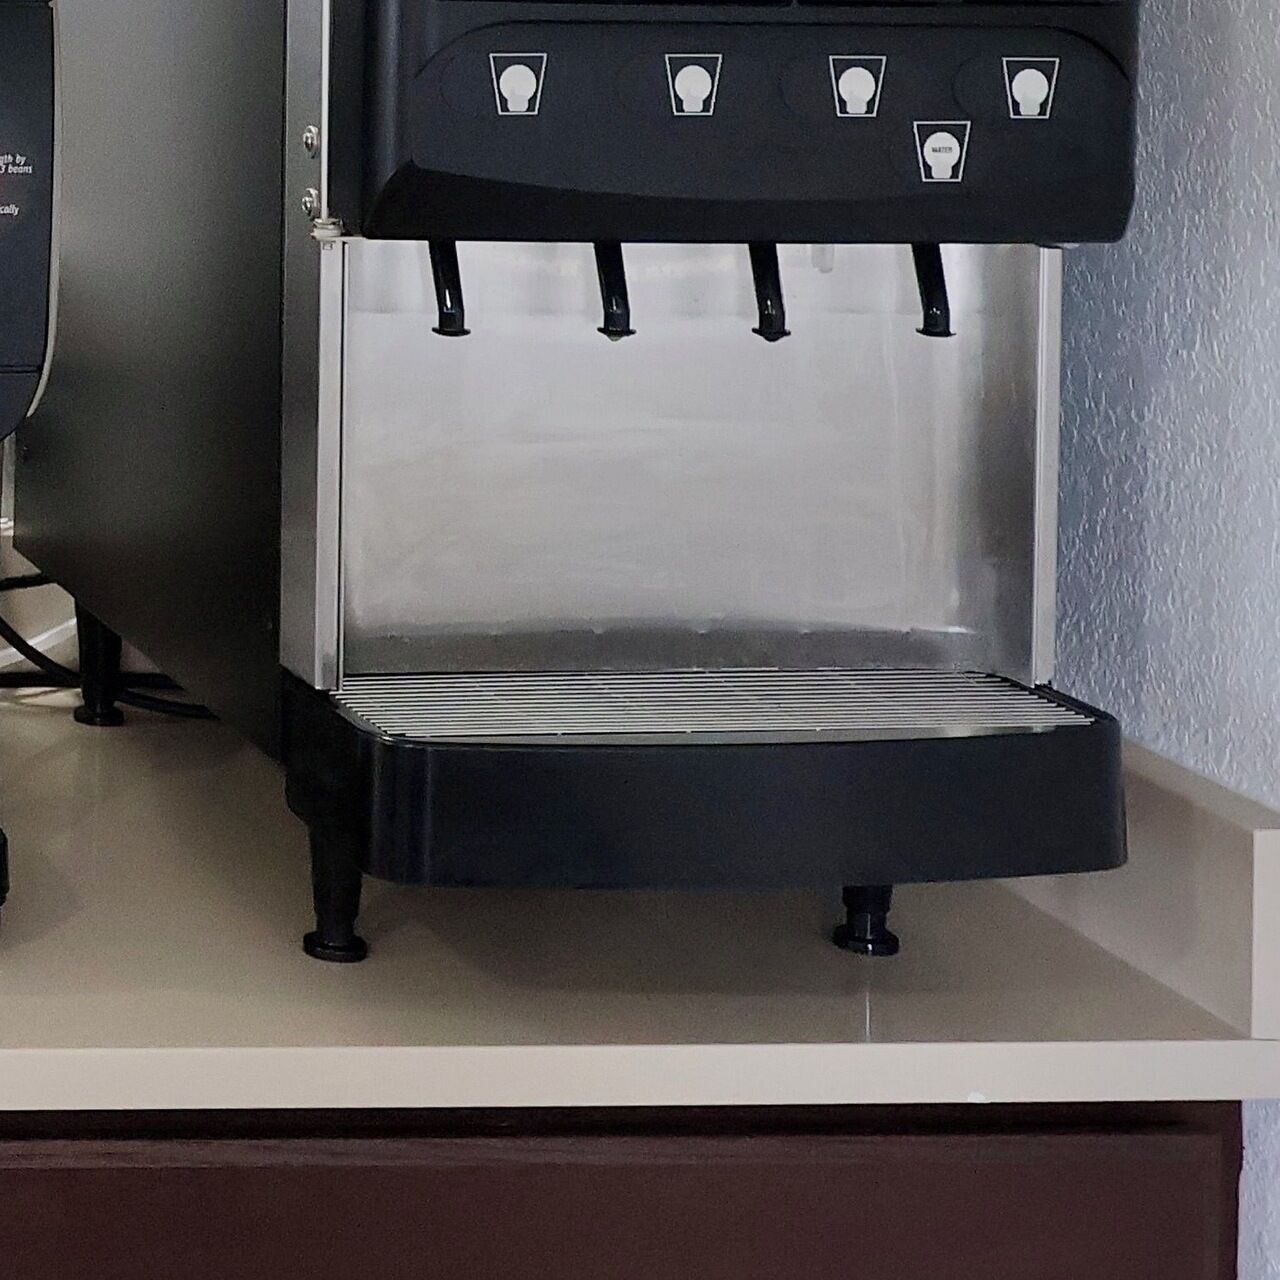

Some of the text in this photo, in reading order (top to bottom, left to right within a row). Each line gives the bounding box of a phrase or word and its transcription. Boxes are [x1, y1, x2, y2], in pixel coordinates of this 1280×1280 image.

[15, 154, 27, 165] by
[0, 165, 6, 174] 3
[7, 165, 33, 174] beans
